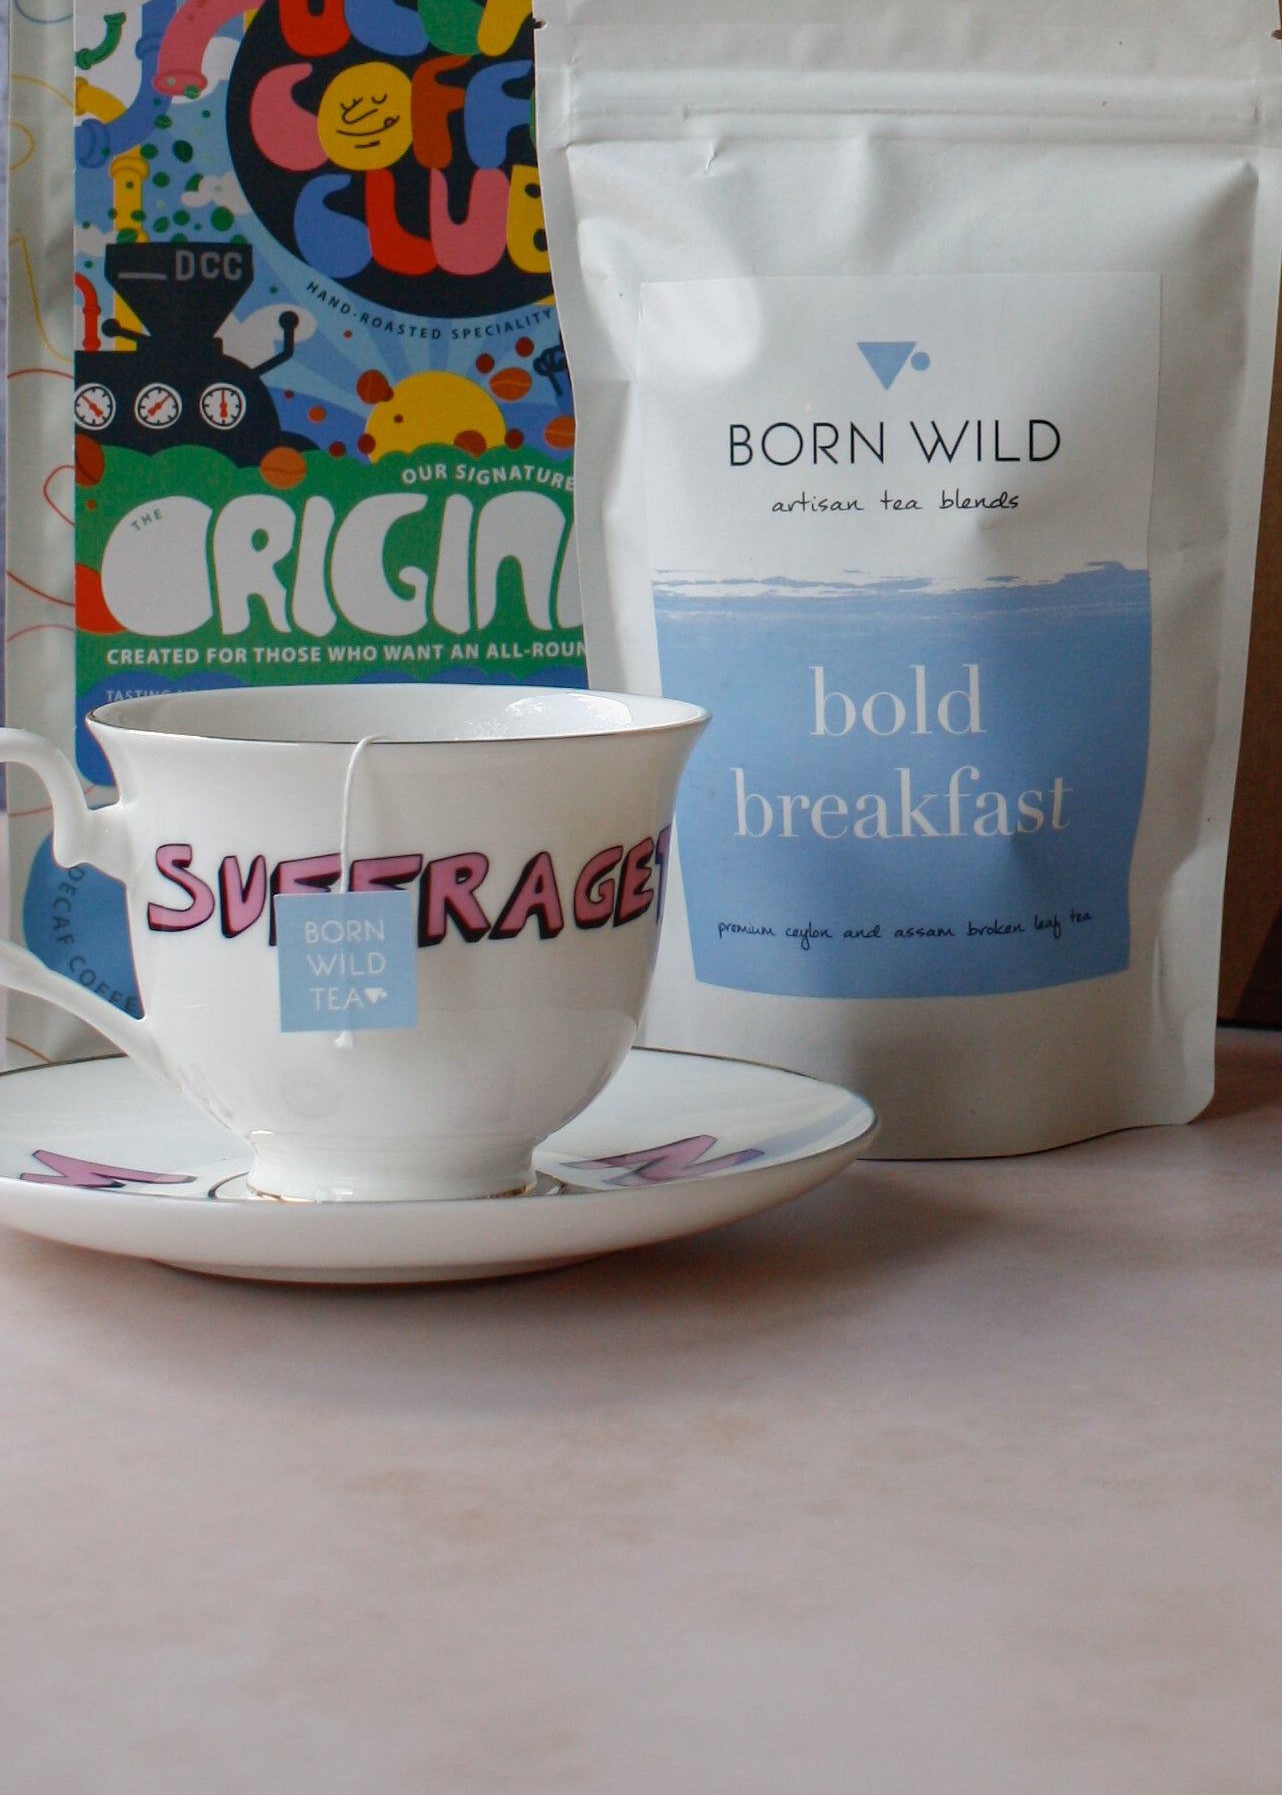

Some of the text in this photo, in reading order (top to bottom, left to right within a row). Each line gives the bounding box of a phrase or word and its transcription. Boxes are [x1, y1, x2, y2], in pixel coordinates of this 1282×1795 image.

[175, 249, 243, 281] DCC
[306, 281, 554, 340] HAND-ROASTED SPECIALITY
[728, 419, 1062, 466] BORN WILD
[401, 463, 575, 492] OUR SIGNATURE
[771, 490, 1020, 514] artisan tea blends
[130, 508, 163, 531] THE
[106, 647, 200, 666] CREATED
[206, 647, 247, 665] FOR
[253, 646, 322, 664] THOSE
[326, 645, 378, 663] WHO
[383, 644, 444, 661] WANT
[450, 643, 480, 660] AN
[809, 663, 987, 736] bold
[731, 765, 1074, 841] breakfast
[53, 866, 85, 947] DECAF
[304, 919, 385, 944] BORN
[717, 908, 1093, 951] premium ceylon and assam broken leaf tea
[306, 952, 386, 976] WILD
[309, 987, 365, 1011] TEA
